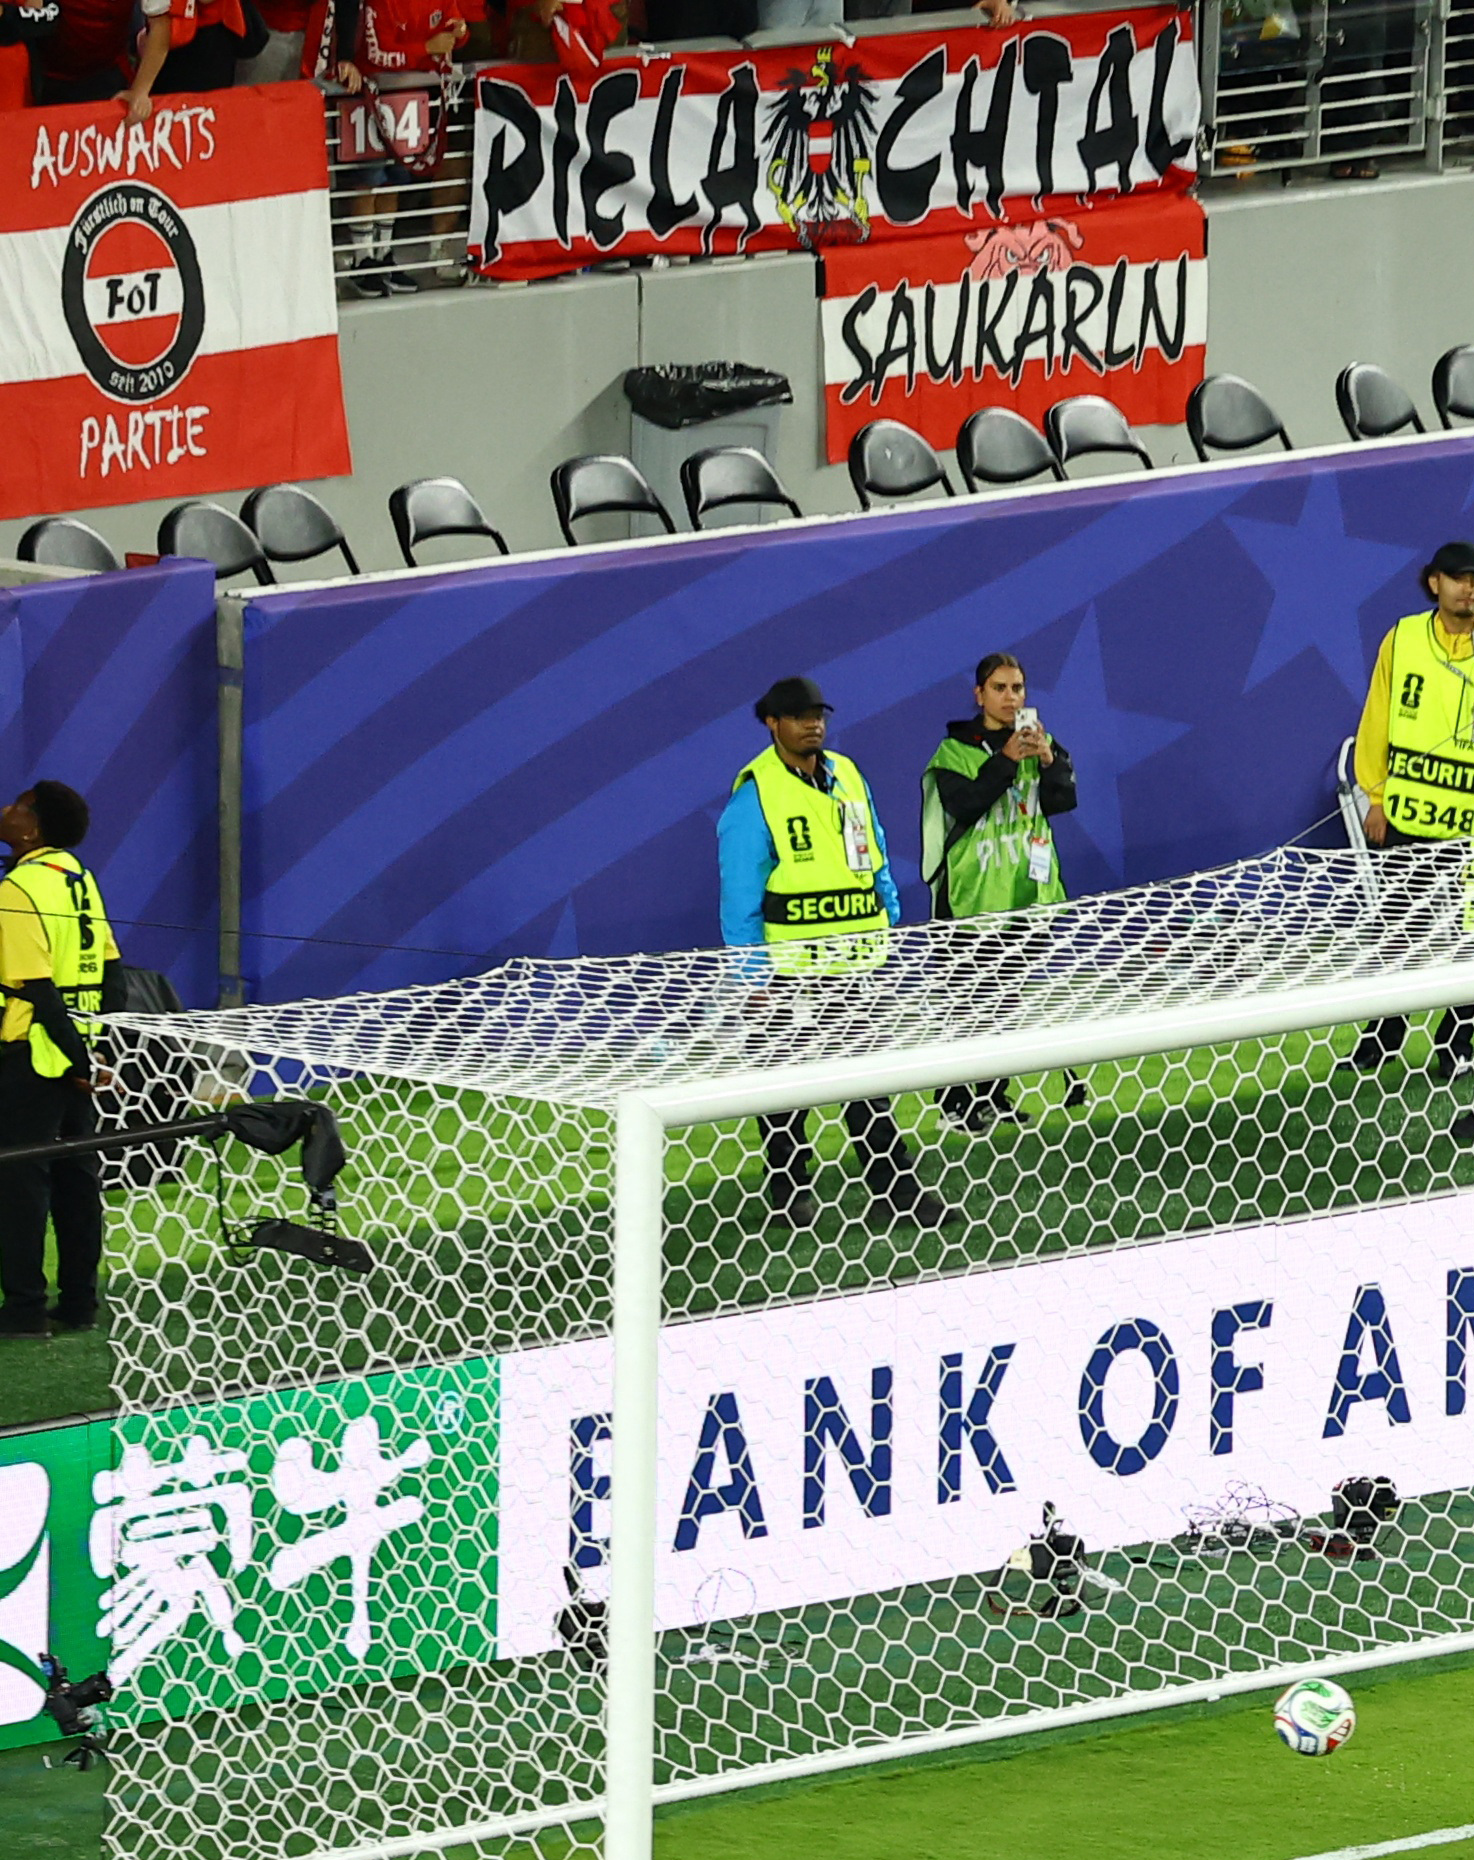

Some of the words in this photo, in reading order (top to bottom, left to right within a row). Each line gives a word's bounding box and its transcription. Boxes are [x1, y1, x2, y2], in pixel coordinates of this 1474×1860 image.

[350, 100, 421, 154] 104
[139, 360, 175, 393] 2010
[80, 404, 210, 478] PARTIE
[1077, 1299, 1274, 1477] OF
[90, 1414, 432, 1687] 蒙牛
